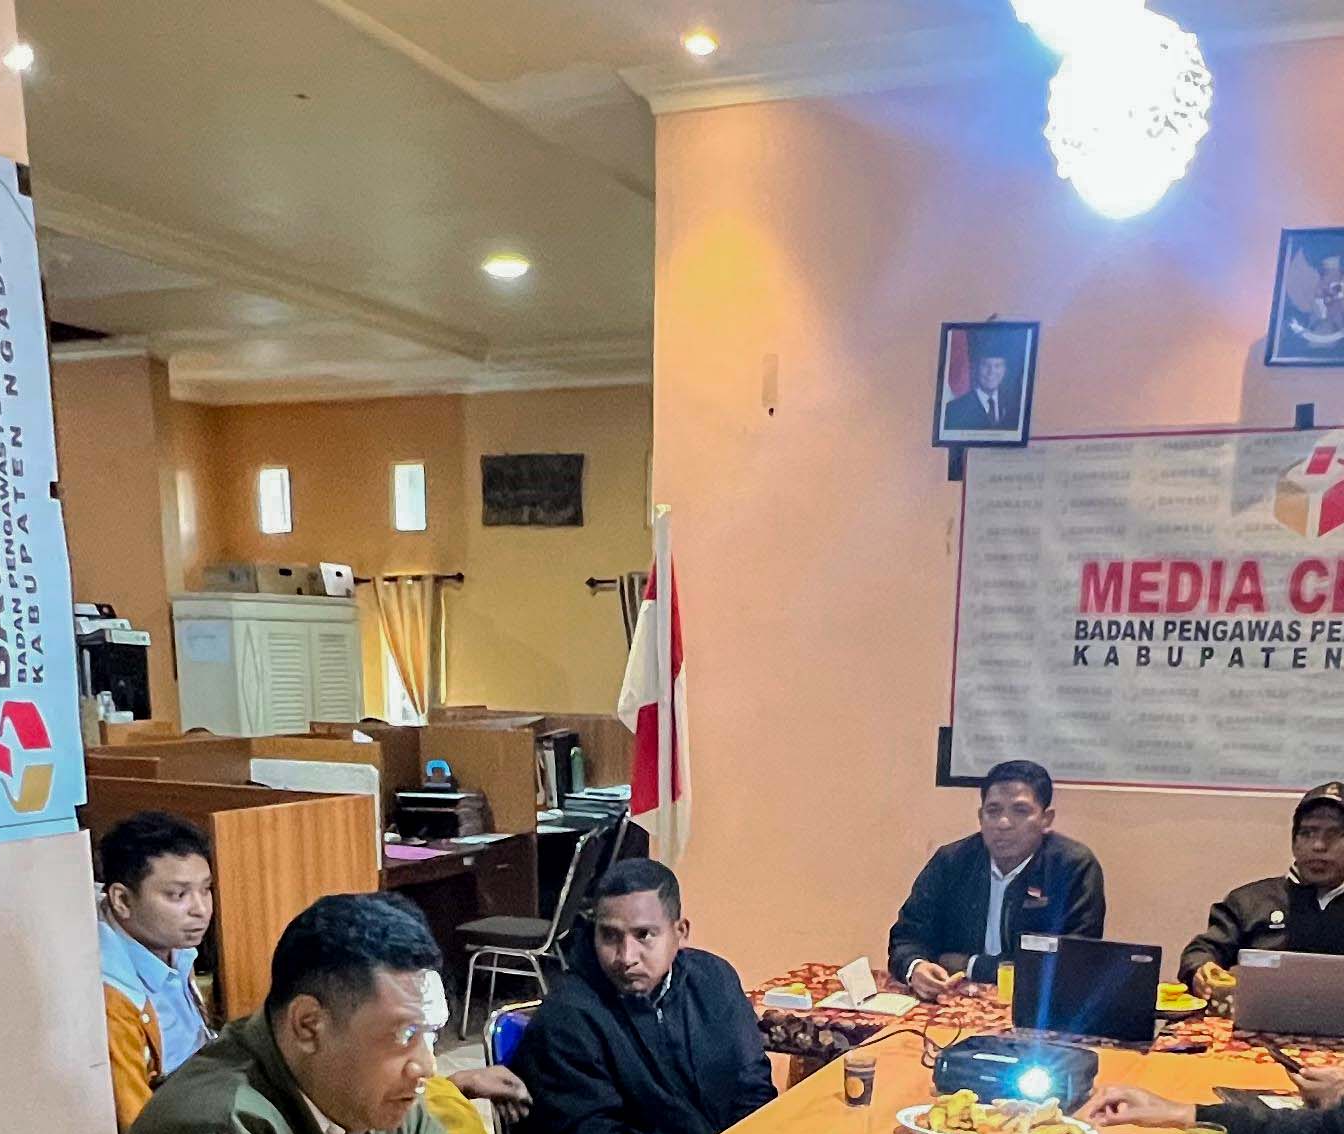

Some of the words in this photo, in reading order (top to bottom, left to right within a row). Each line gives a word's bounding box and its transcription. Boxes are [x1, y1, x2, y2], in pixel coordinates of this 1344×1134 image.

[9, 425, 45, 684] KABUPATEN
[1078, 560, 1267, 614] MEDIA
[12, 598, 27, 683] BADAN
[1072, 645, 1344, 670] KABUPATEN
[1074, 620, 1154, 642] BADAN
[1162, 620, 1301, 642] PENGAWAS
